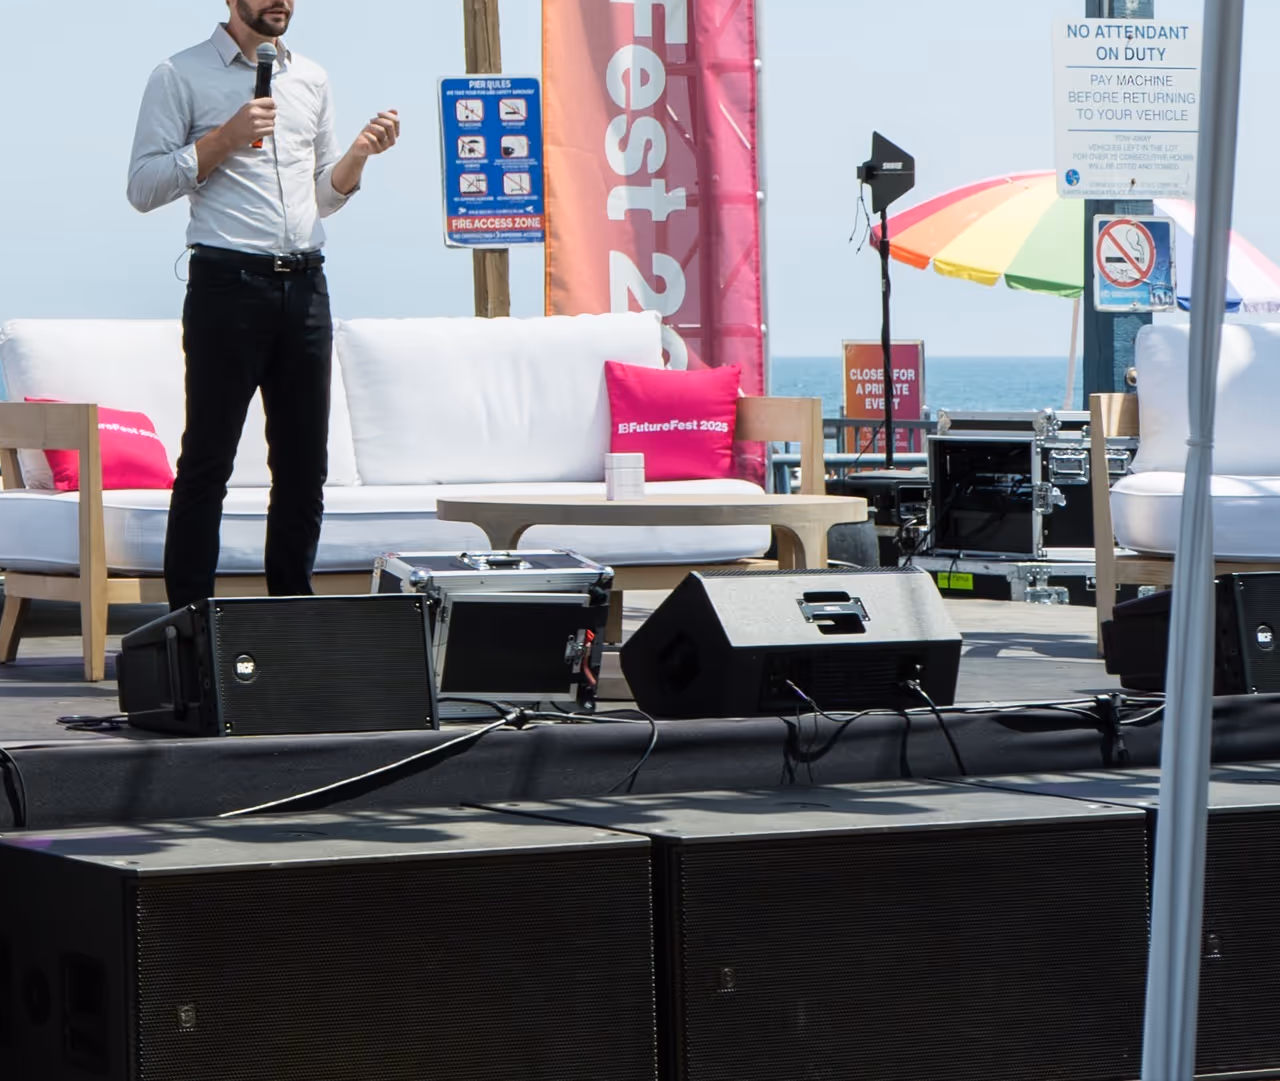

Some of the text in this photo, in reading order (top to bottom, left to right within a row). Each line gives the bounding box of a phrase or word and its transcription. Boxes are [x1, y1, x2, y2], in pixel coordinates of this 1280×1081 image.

[1067, 24, 1189, 40] NO ATTENDANT
[1096, 46, 1166, 61] ON DUTY
[469, 80, 485, 89] PIER
[1090, 75, 1173, 87] PAY MACHINE
[1068, 91, 1196, 104] BEFORE RETURNING
[1076, 108, 1188, 121] TO YOUR VEHICLE
[452, 217, 541, 229] FIRE ACCESS ZONE
[849, 368, 915, 381] CLOSE FOR
[856, 384, 863, 395] A
[865, 398, 900, 410] EVET
[700, 421, 728, 433] 2025
